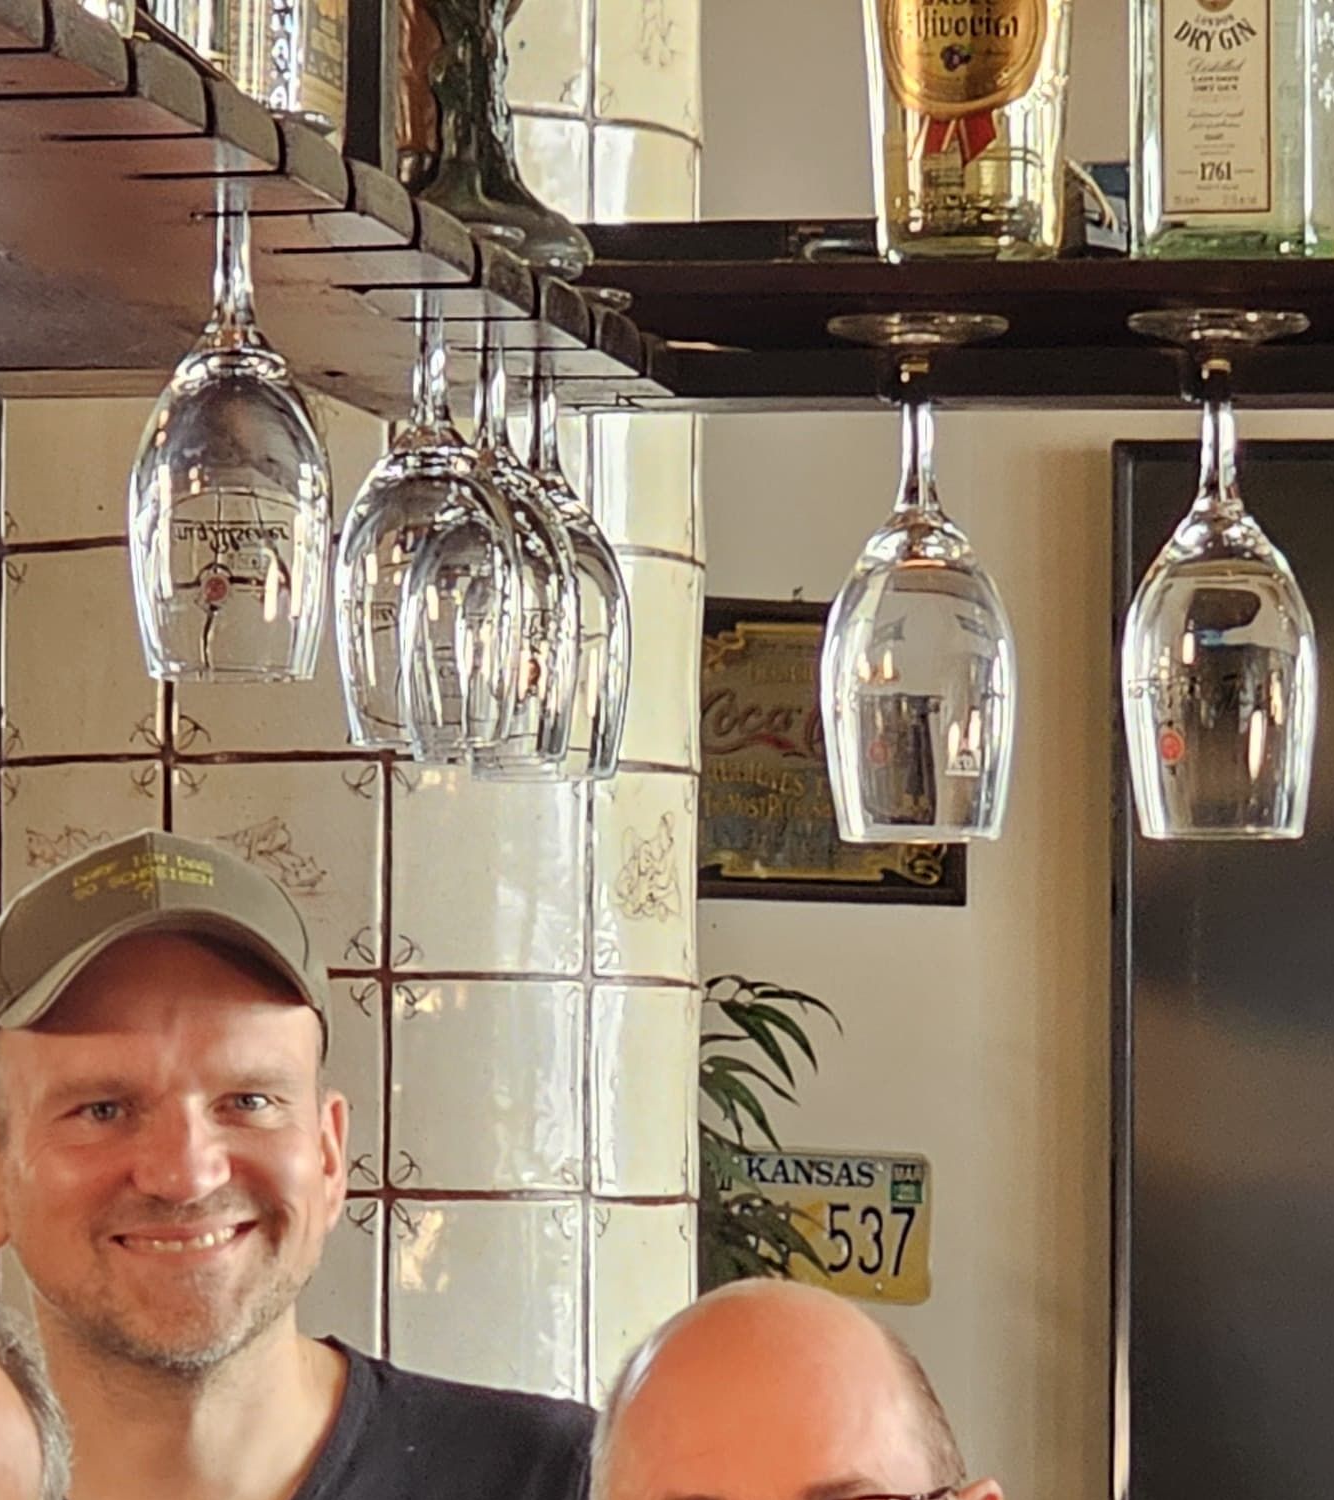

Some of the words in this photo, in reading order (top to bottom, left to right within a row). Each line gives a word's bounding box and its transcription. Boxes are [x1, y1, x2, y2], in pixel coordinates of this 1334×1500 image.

[1174, 20, 1213, 52] DRY
[1218, 18, 1257, 51] GIN
[1199, 161, 1233, 182] 1761
[745, 1157, 875, 1187] KANSAS
[827, 1203, 916, 1277] 537
